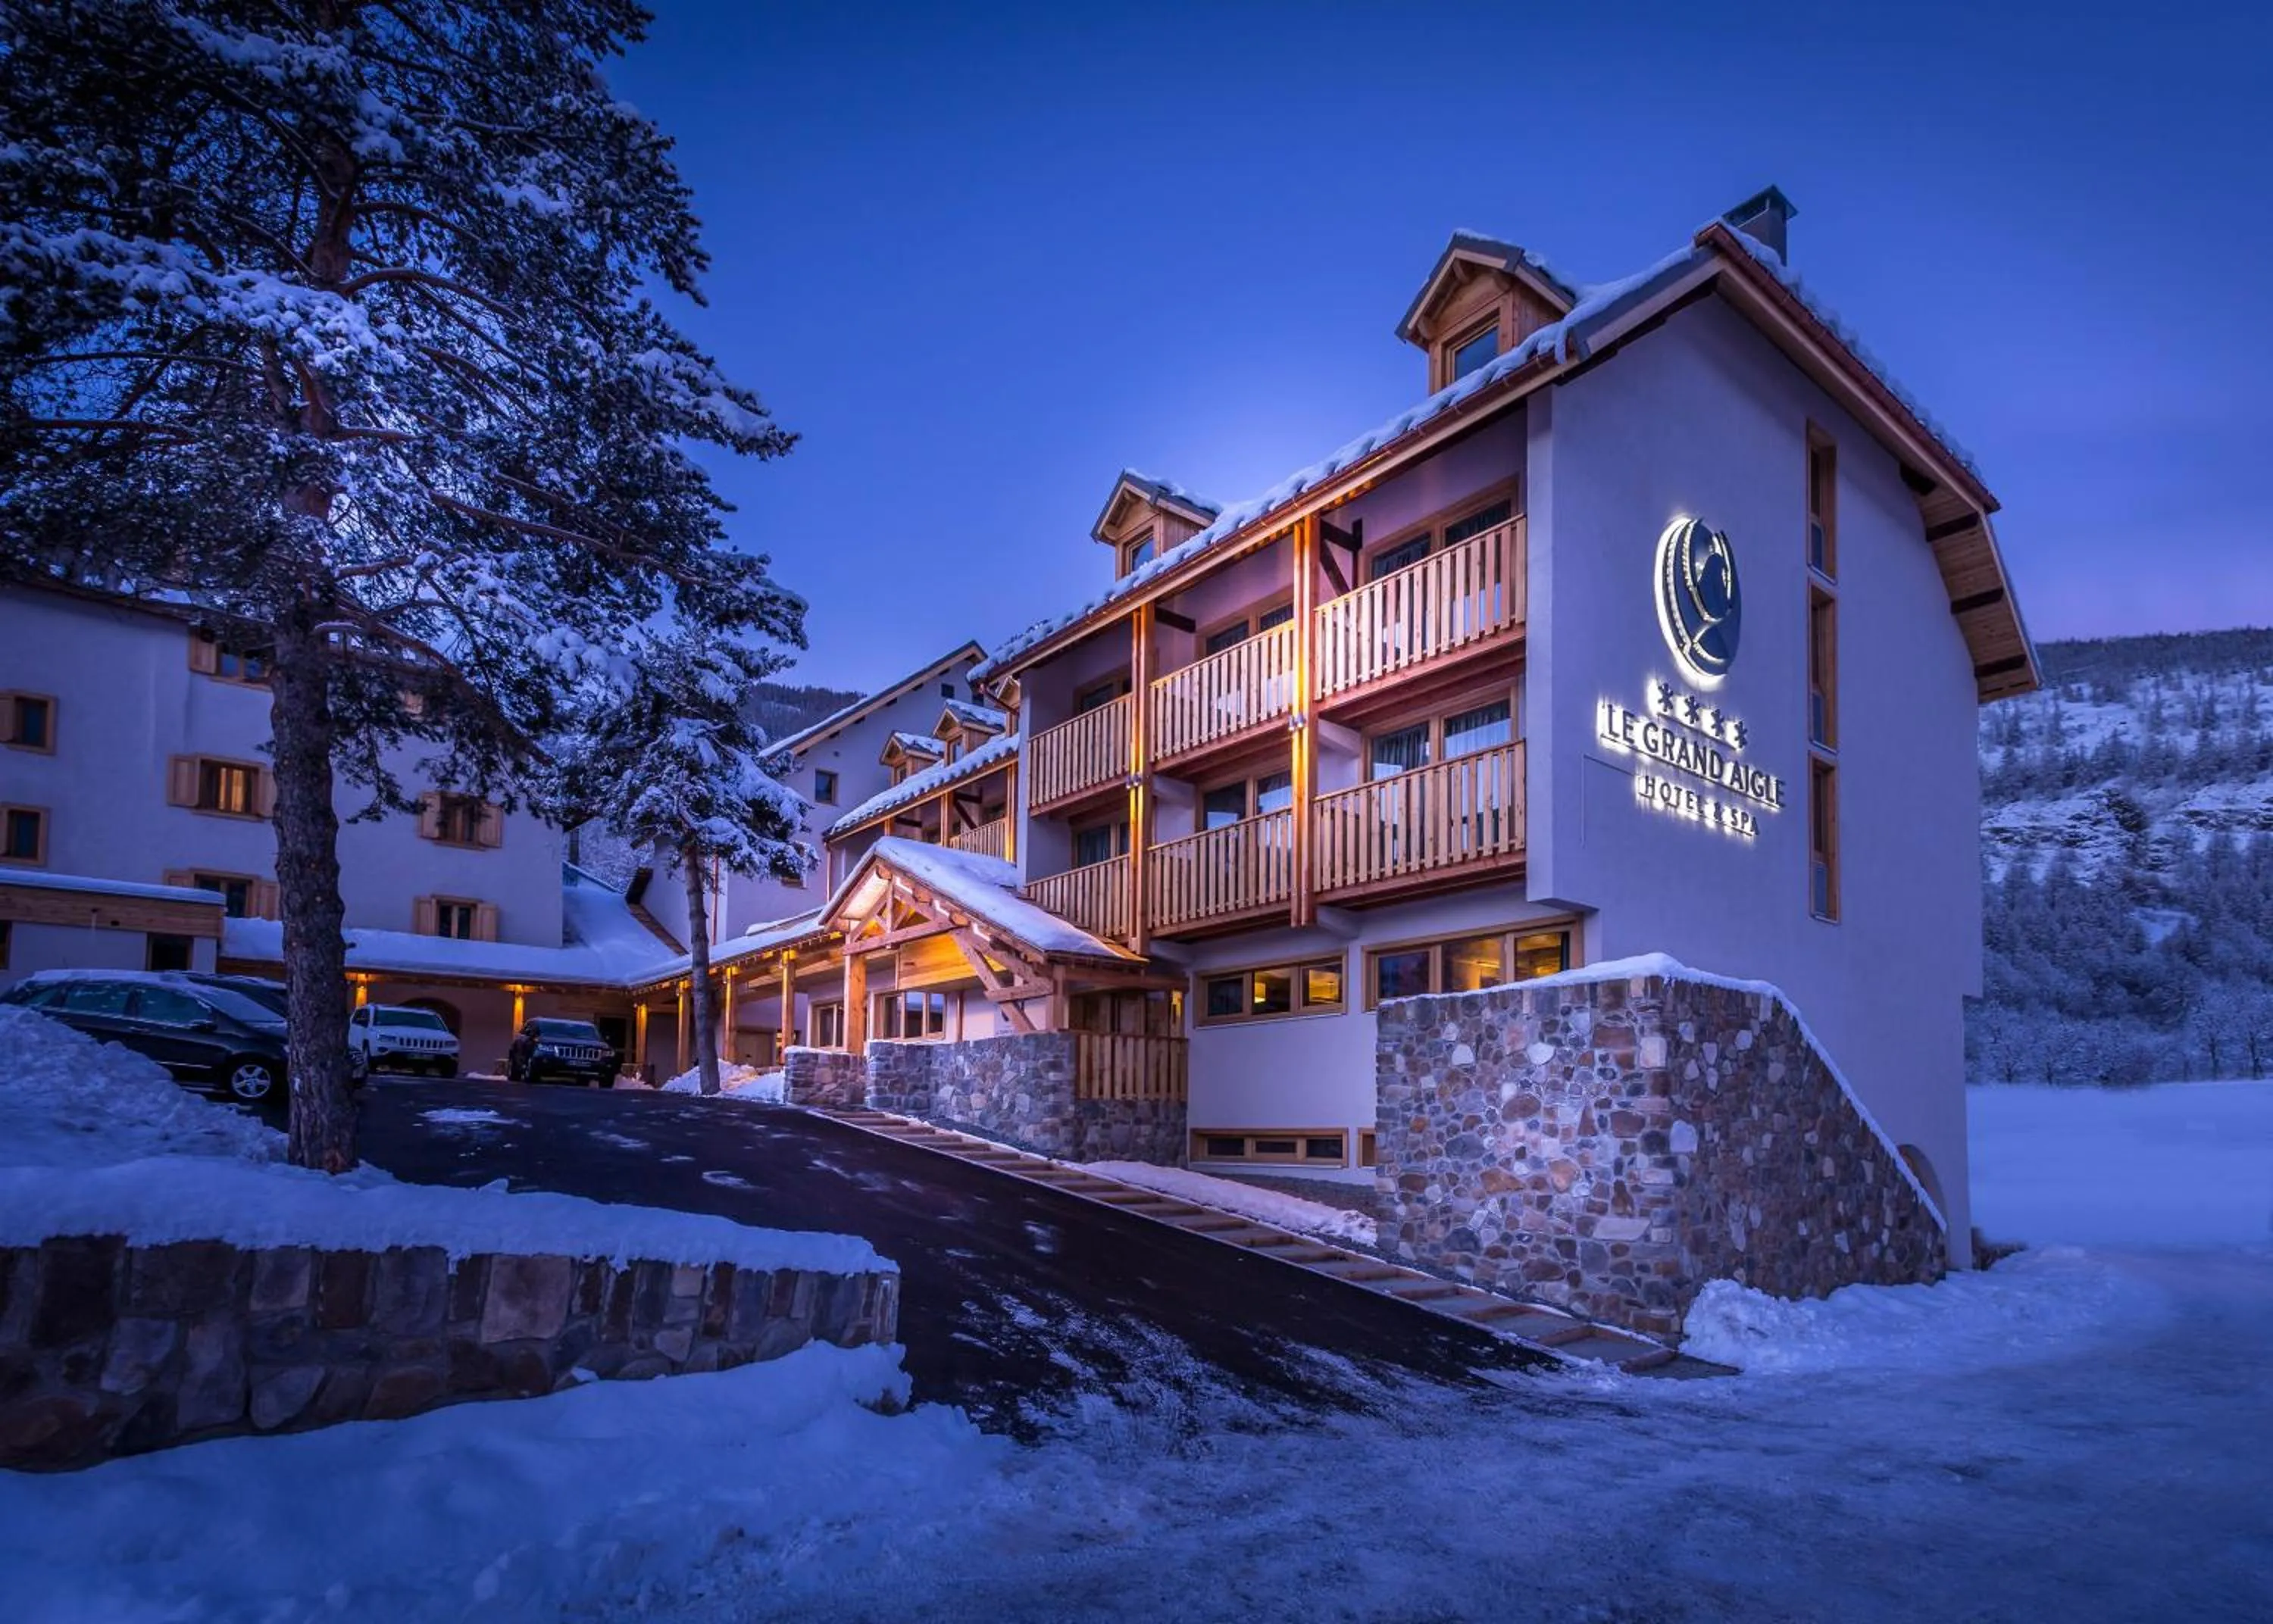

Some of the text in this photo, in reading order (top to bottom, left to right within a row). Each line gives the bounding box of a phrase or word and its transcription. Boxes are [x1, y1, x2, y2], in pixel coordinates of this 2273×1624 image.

[1607, 704, 1786, 807] LE GRAND AIGLE
[1645, 775, 1759, 835] HOTEL & SPA
